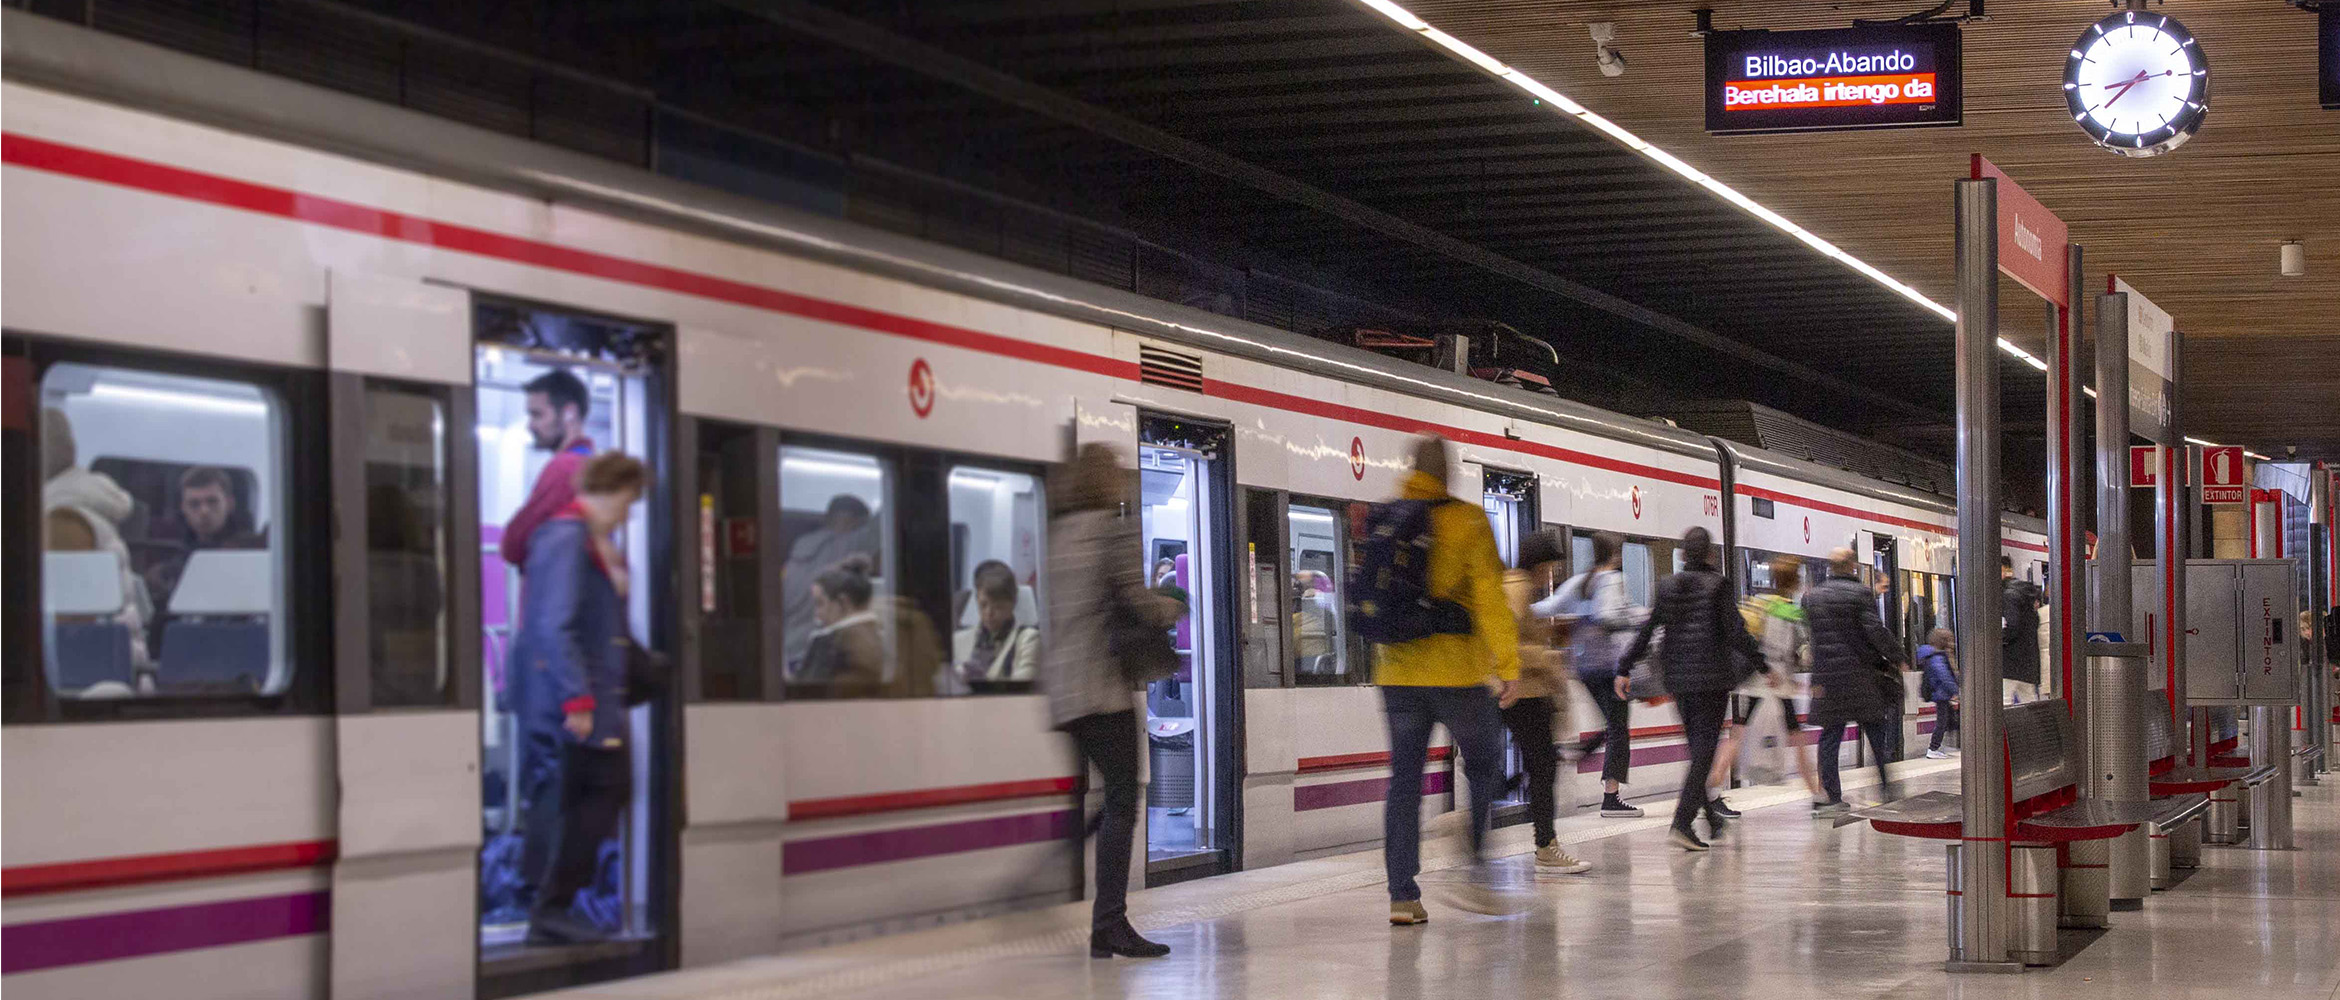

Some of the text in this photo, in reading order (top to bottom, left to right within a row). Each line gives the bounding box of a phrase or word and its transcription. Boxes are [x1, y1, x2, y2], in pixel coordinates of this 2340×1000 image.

[1745, 49, 1915, 77] Bilbao-Abando
[1725, 78, 1933, 106] Berehala irtengo da
[2204, 489, 2243, 501] EXTINTOR
[2262, 597, 2272, 676] EXTINTOR
